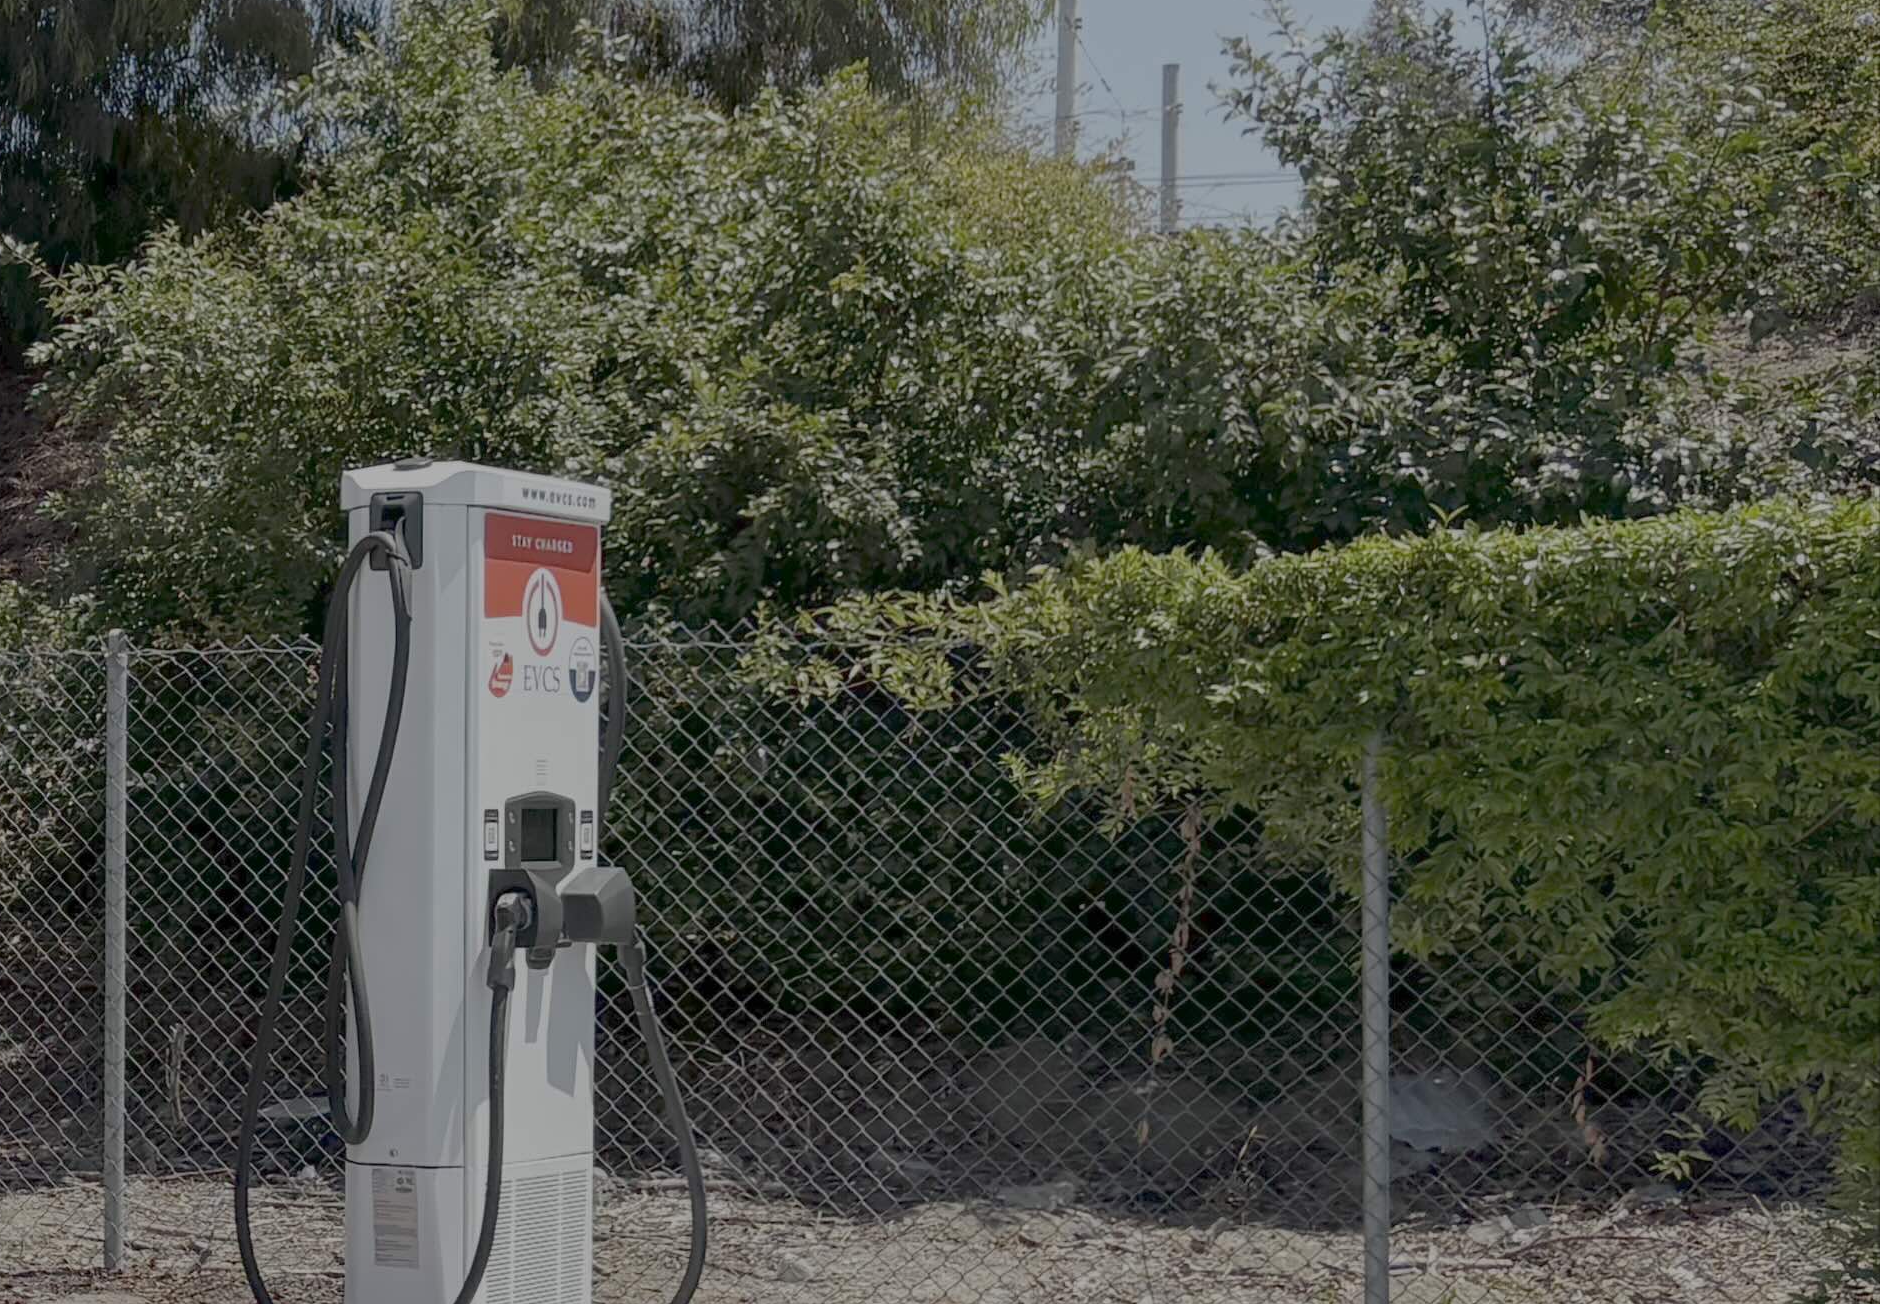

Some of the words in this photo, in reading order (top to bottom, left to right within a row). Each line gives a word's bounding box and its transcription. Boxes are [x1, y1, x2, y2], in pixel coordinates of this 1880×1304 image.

[521, 487, 597, 509] www.evcs.com
[512, 534, 533, 547] STAY
[535, 537, 573, 554] CHARGED
[523, 664, 561, 693] EVCS
